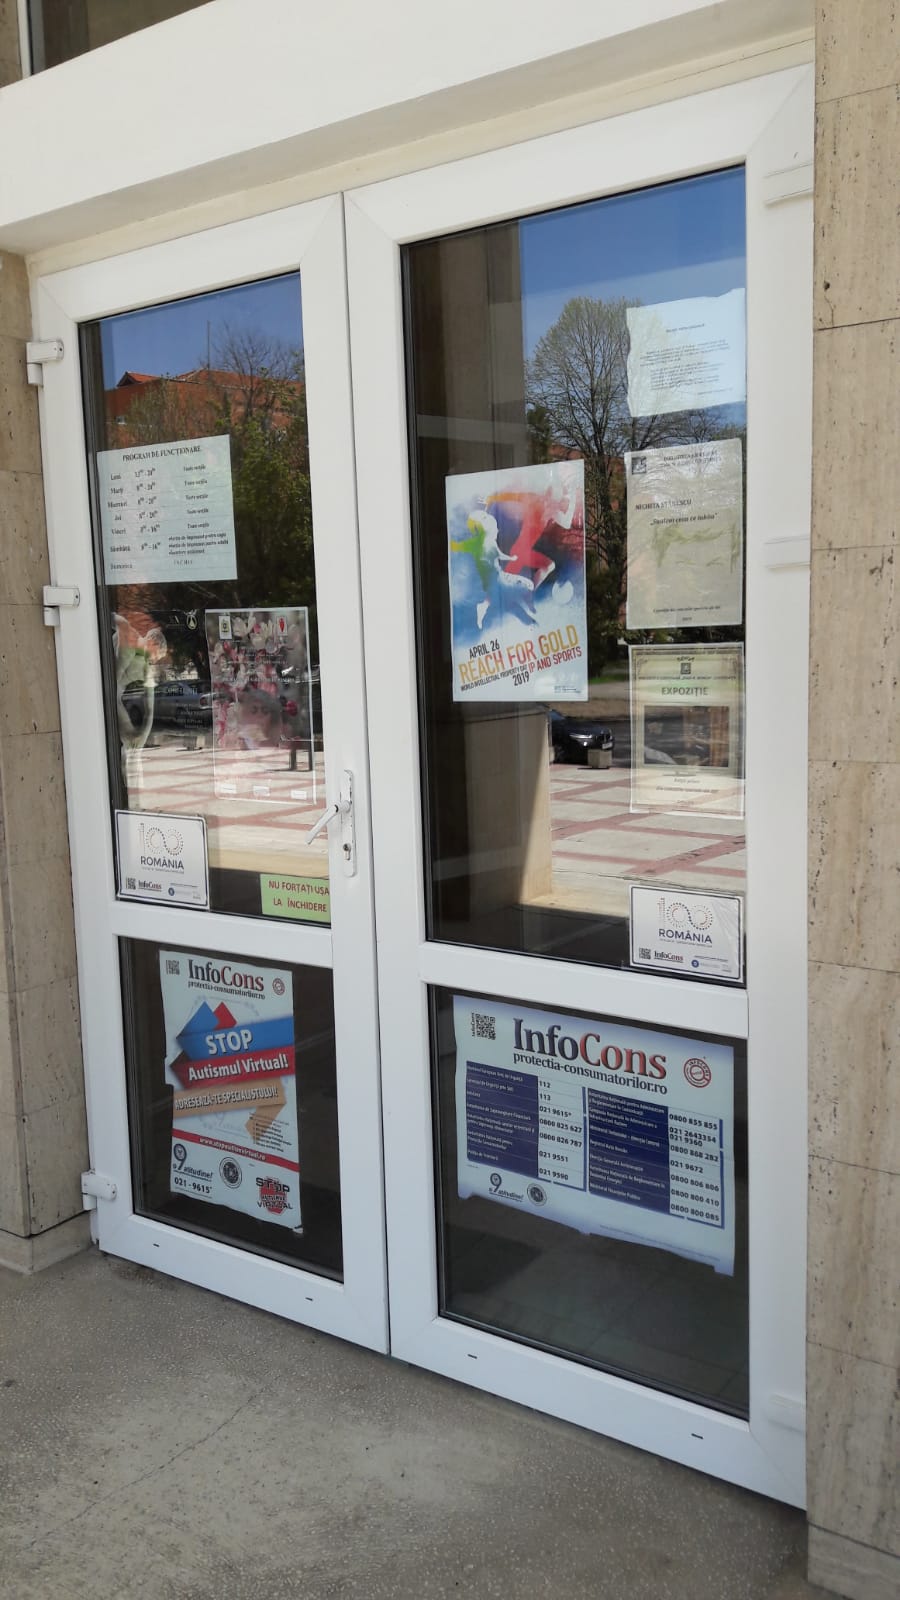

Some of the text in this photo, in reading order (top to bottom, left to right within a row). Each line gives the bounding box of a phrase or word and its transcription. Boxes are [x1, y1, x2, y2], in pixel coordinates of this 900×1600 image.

[122, 451, 151, 462] PROGRAM
[151, 450, 160, 458] DE
[458, 624, 579, 684] REACH FOR GOLD
[469, 638, 500, 660] APRIL 26
[528, 646, 582, 673] IP AND SPORTS
[512, 671, 530, 687] 2019
[140, 855, 185, 870] ROMÂNIA
[138, 879, 162, 890] InfoCons
[268, 880, 280, 890] NU
[273, 898, 328, 913] LA ÎNCHIDERE
[658, 928, 713, 944] ROMÂNIA
[654, 950, 684, 962] InfoCons
[188, 958, 265, 992] InfoCons
[206, 1029, 253, 1055] STOP
[513, 1017, 667, 1081] InfoCons
[189, 1053, 289, 1082] Autismul Virtual!
[513, 1051, 668, 1095] protectia-consumatorilor.ro
[539, 1105, 551, 1113] 021
[539, 1167, 551, 1176] 021
[670, 1160, 683, 1169] 021
[174, 1177, 187, 1187] 021
